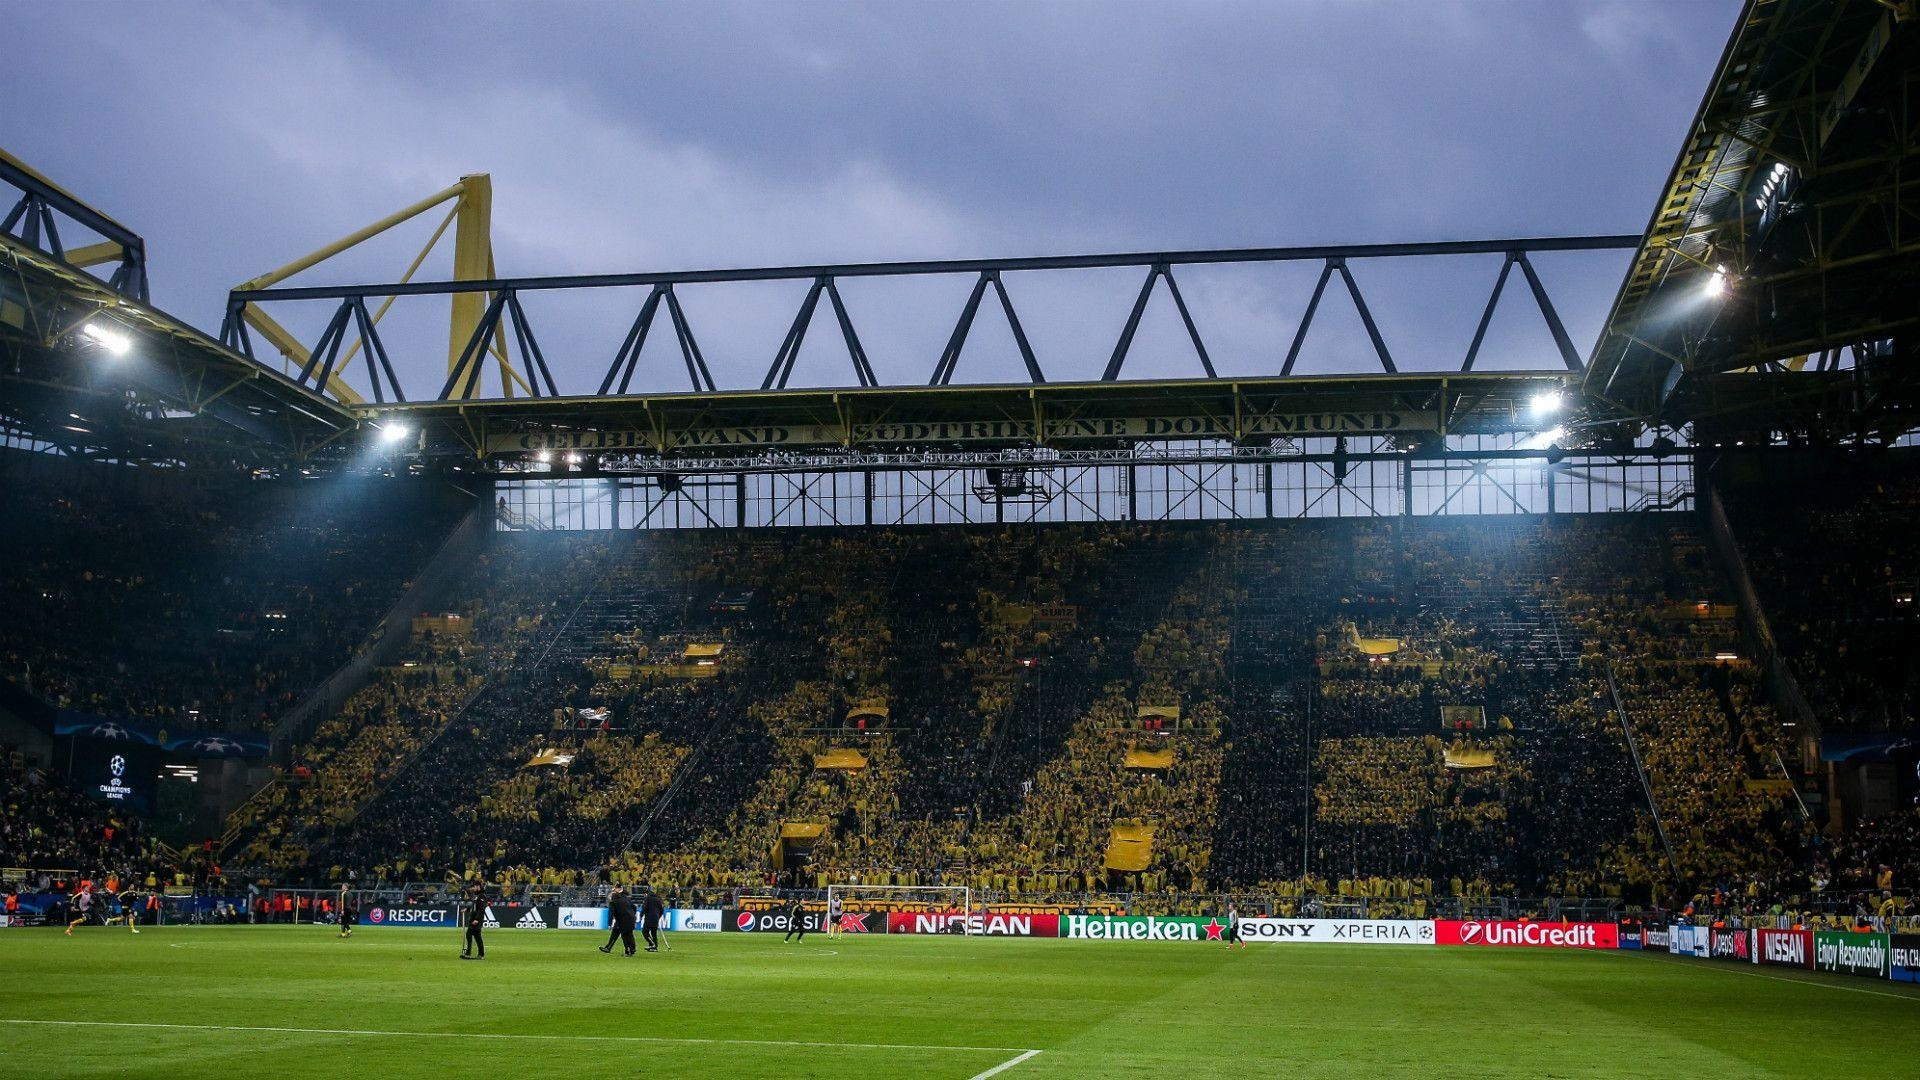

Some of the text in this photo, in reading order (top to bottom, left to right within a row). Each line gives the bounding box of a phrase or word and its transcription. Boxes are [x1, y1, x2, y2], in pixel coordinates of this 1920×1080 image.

[520, 430, 648, 449] GELBE
[672, 427, 789, 446] WAND
[1144, 412, 1400, 434] DORTMUND
[99, 784, 131, 794] CHAMPIONS
[106, 792, 124, 800] LEAGUE
[388, 909, 447, 922] RESPECT
[515, 920, 548, 929] adidas
[1067, 915, 1199, 940] Heineken
[1241, 923, 1411, 939] SONY XPERIA
[1485, 923, 1596, 946] UniCredit
[1717, 931, 1734, 956] pepsi
[1765, 932, 1804, 964] NISSAN
[1818, 937, 1886, 977] Enjoy Responsibly
[1891, 947, 1909, 967] UEFA
